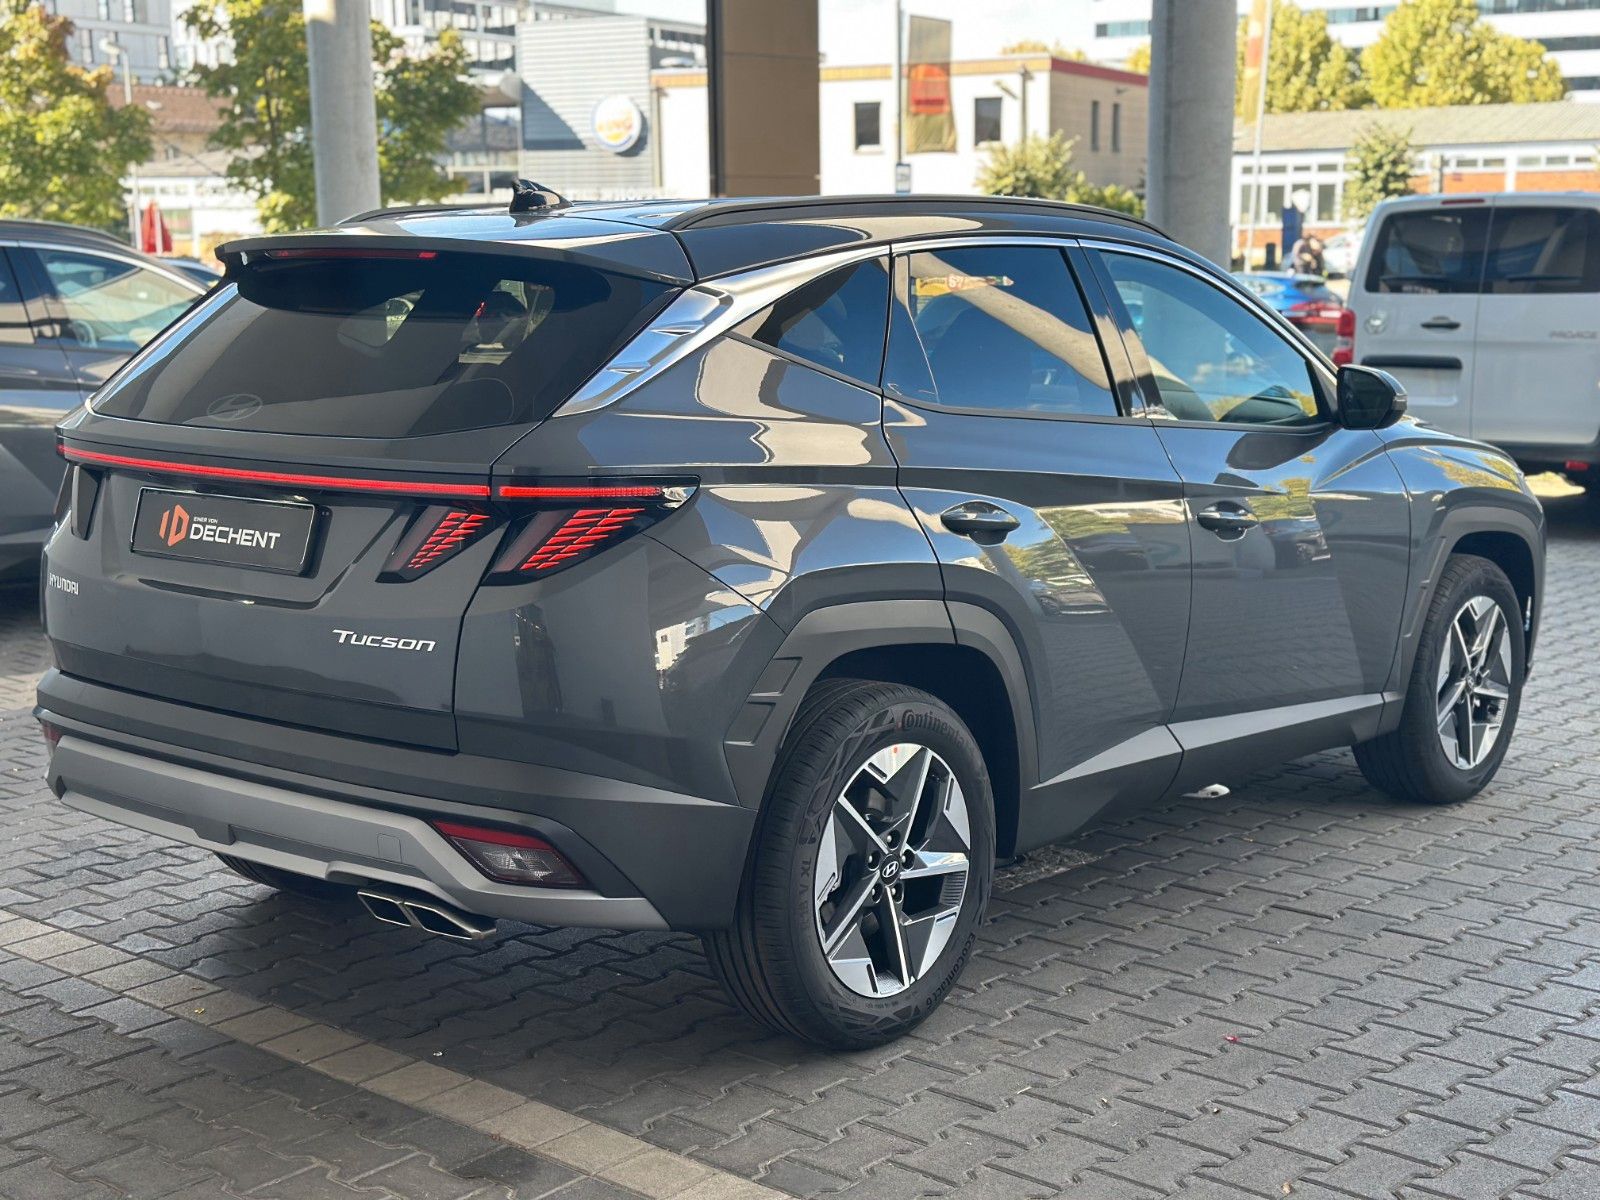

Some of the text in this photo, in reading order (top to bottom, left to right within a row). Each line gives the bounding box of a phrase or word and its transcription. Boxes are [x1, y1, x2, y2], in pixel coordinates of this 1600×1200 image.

[190, 523, 281, 549] DECHENT
[49, 572, 79, 596] HYUNDAI
[901, 708, 967, 748] Continenta
